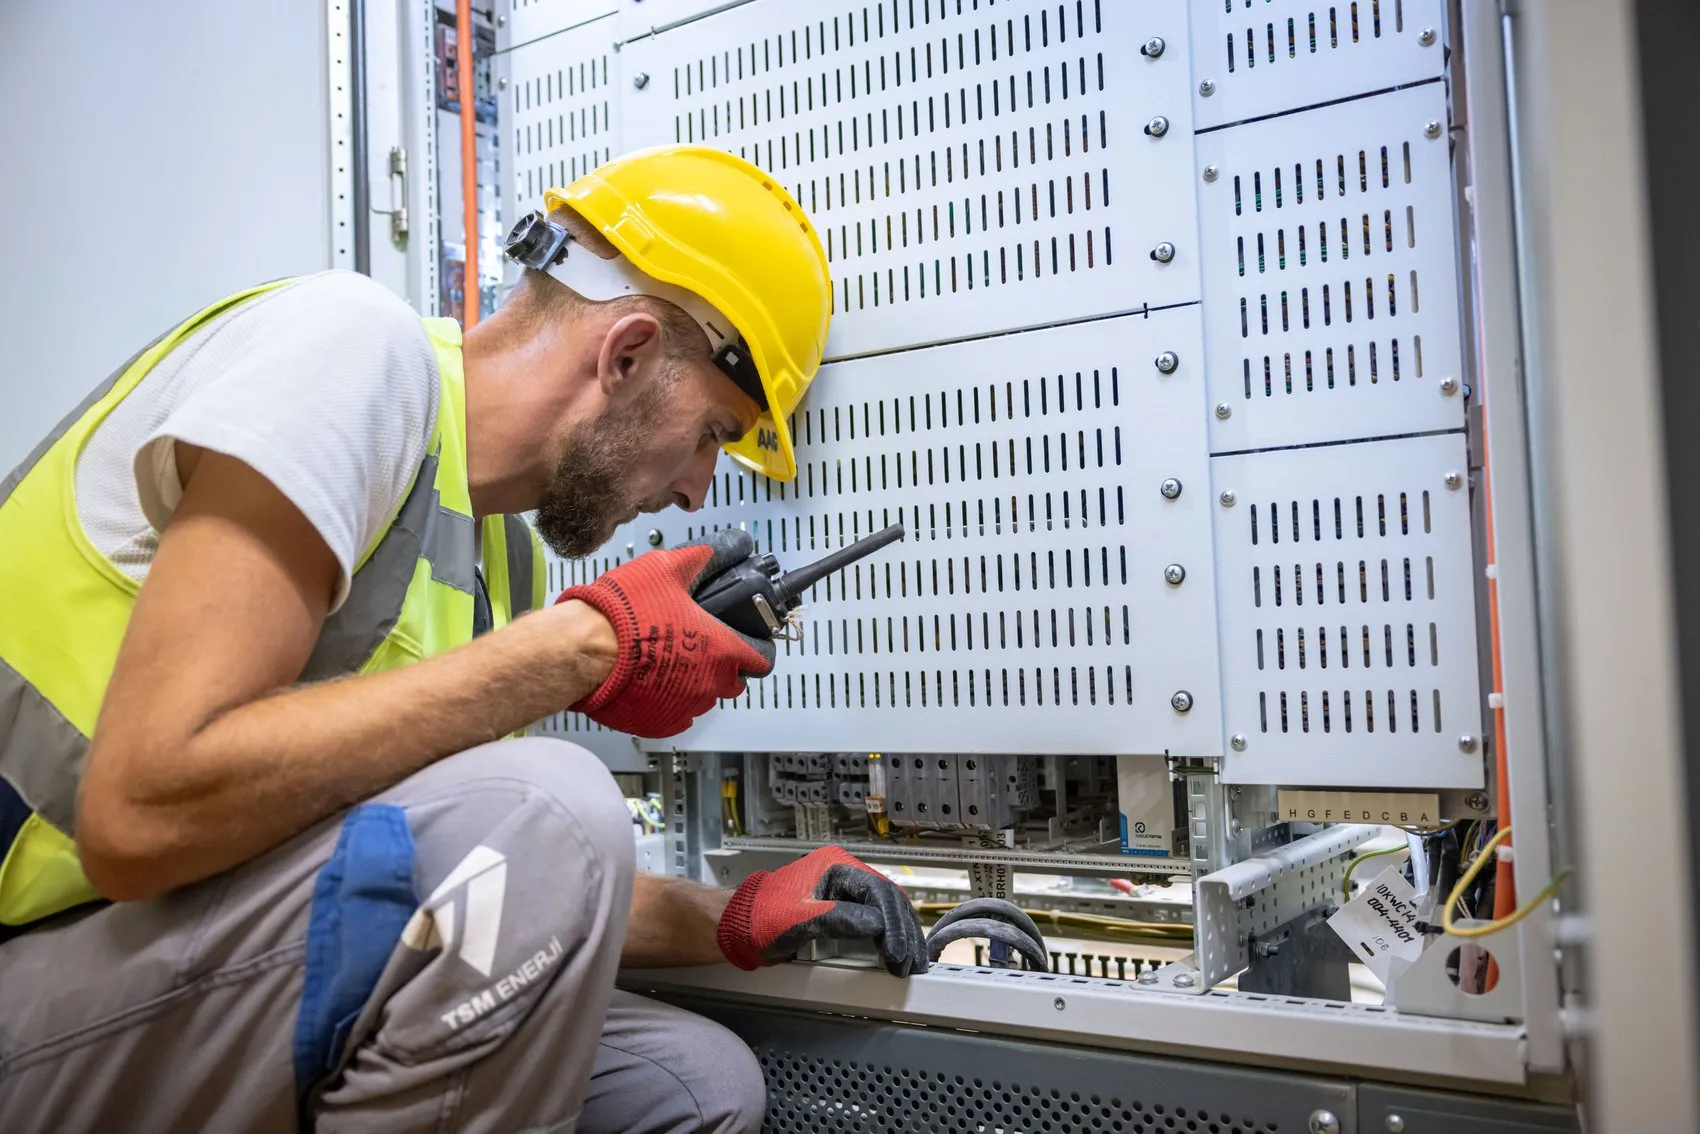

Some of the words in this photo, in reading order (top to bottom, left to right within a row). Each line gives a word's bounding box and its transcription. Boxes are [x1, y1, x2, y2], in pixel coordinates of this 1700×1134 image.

[682, 628, 697, 652] CE
[1289, 809, 1297, 818] H
[1307, 809, 1316, 818] G
[1325, 810, 1332, 818] F
[1343, 810, 1351, 819] E
[1362, 811, 1371, 820] D
[1381, 811, 1390, 821] C
[1400, 812, 1408, 821] B
[1420, 813, 1429, 822] A
[440, 989, 496, 1030] TSM
